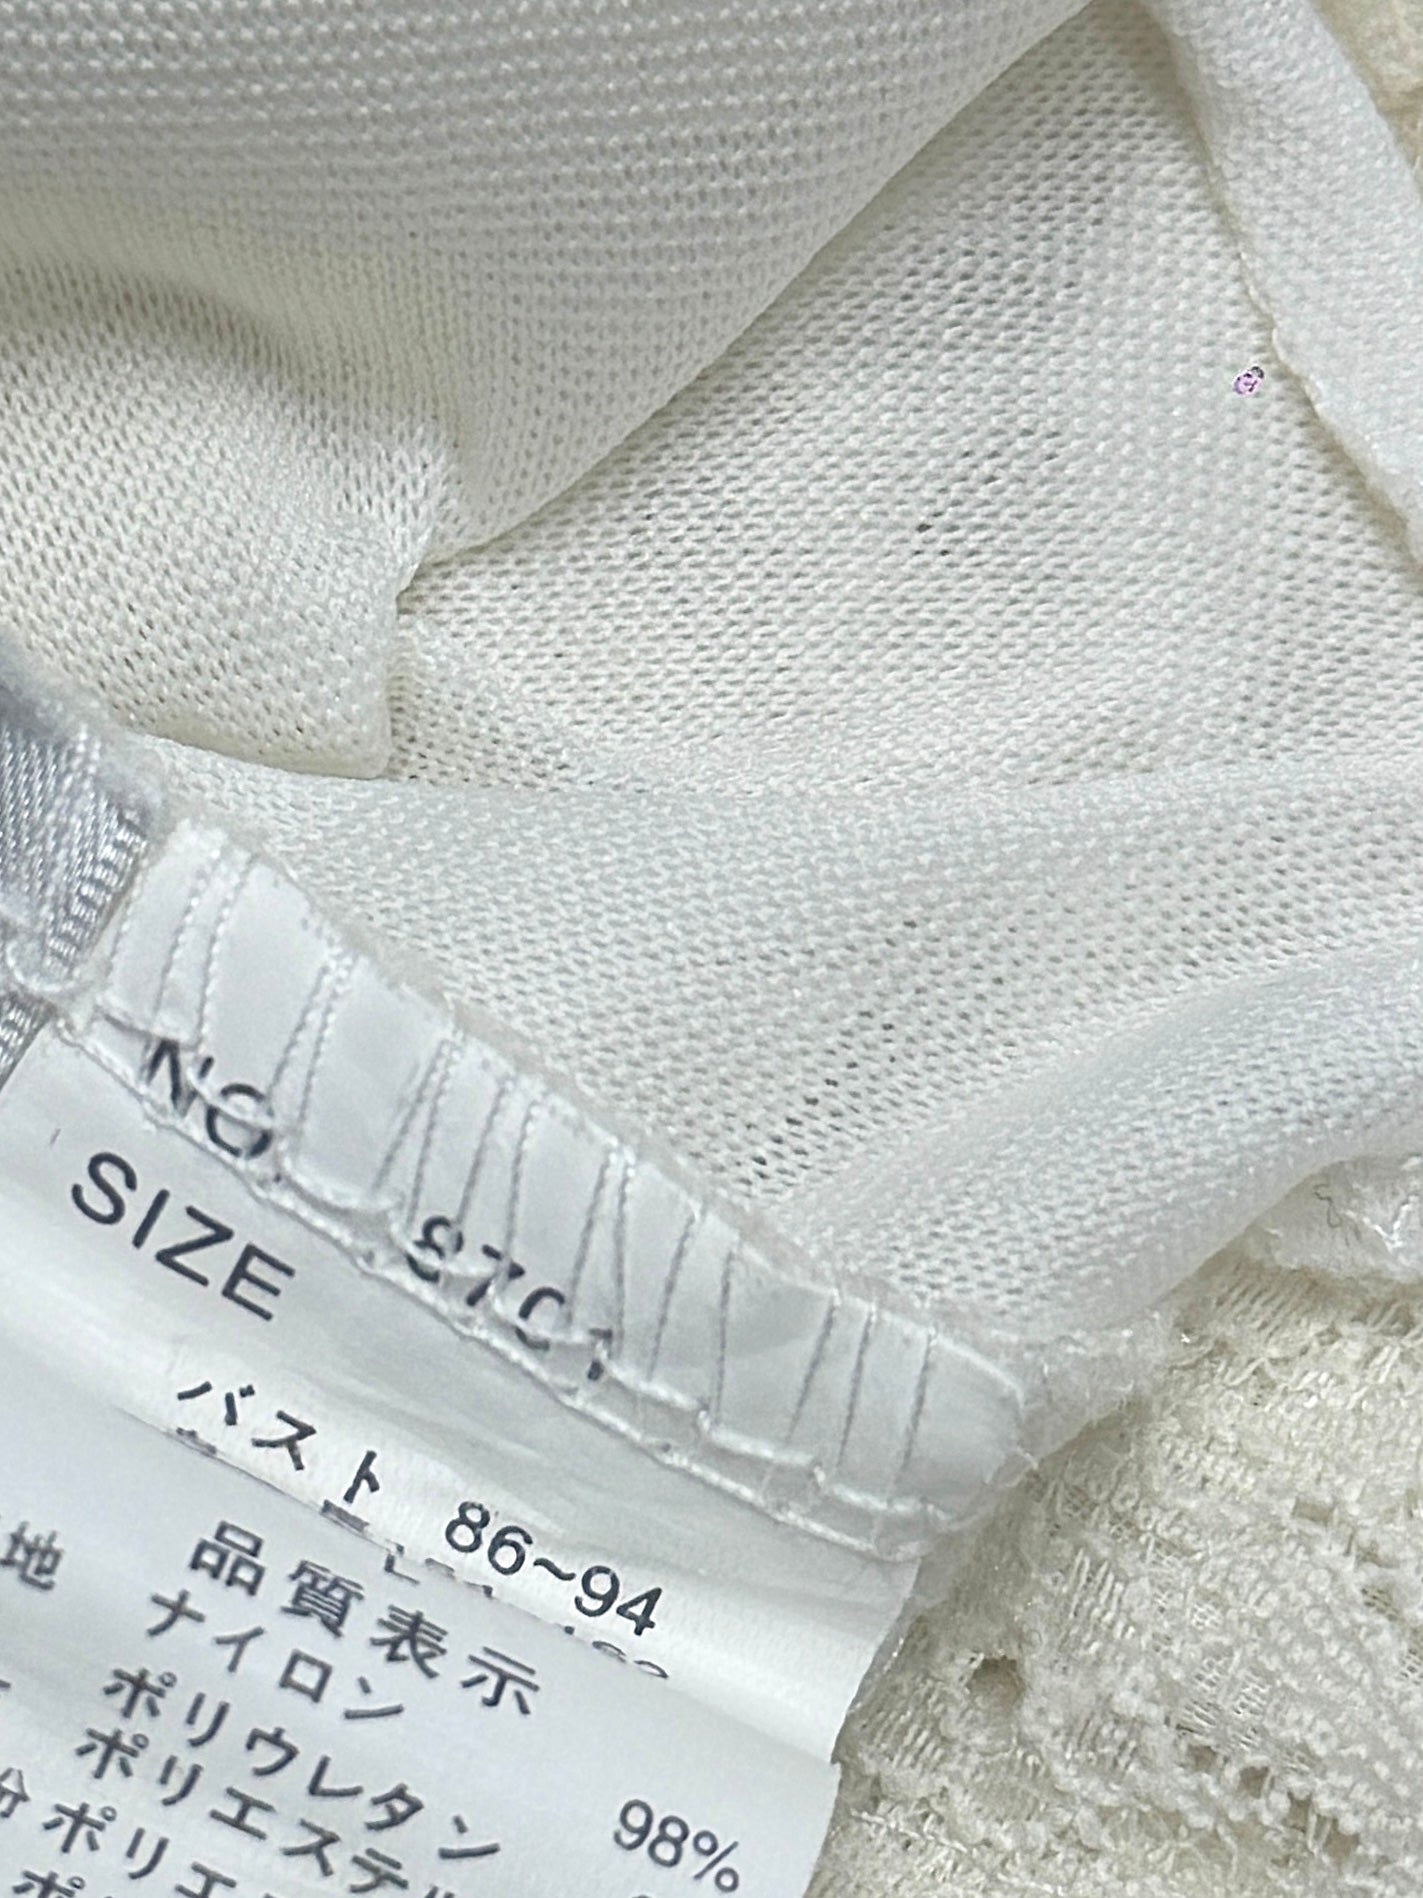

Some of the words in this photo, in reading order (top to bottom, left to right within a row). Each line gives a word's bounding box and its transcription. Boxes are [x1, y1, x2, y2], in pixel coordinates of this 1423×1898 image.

[70, 1151, 297, 1322] SIZE
[176, 1380, 380, 1503] バスト
[189, 1520, 540, 1715] 品質表示
[103, 1666, 501, 1860] ポリウレタン
[146, 1589, 406, 1721] ナイロン
[613, 1798, 740, 1894] 98%
